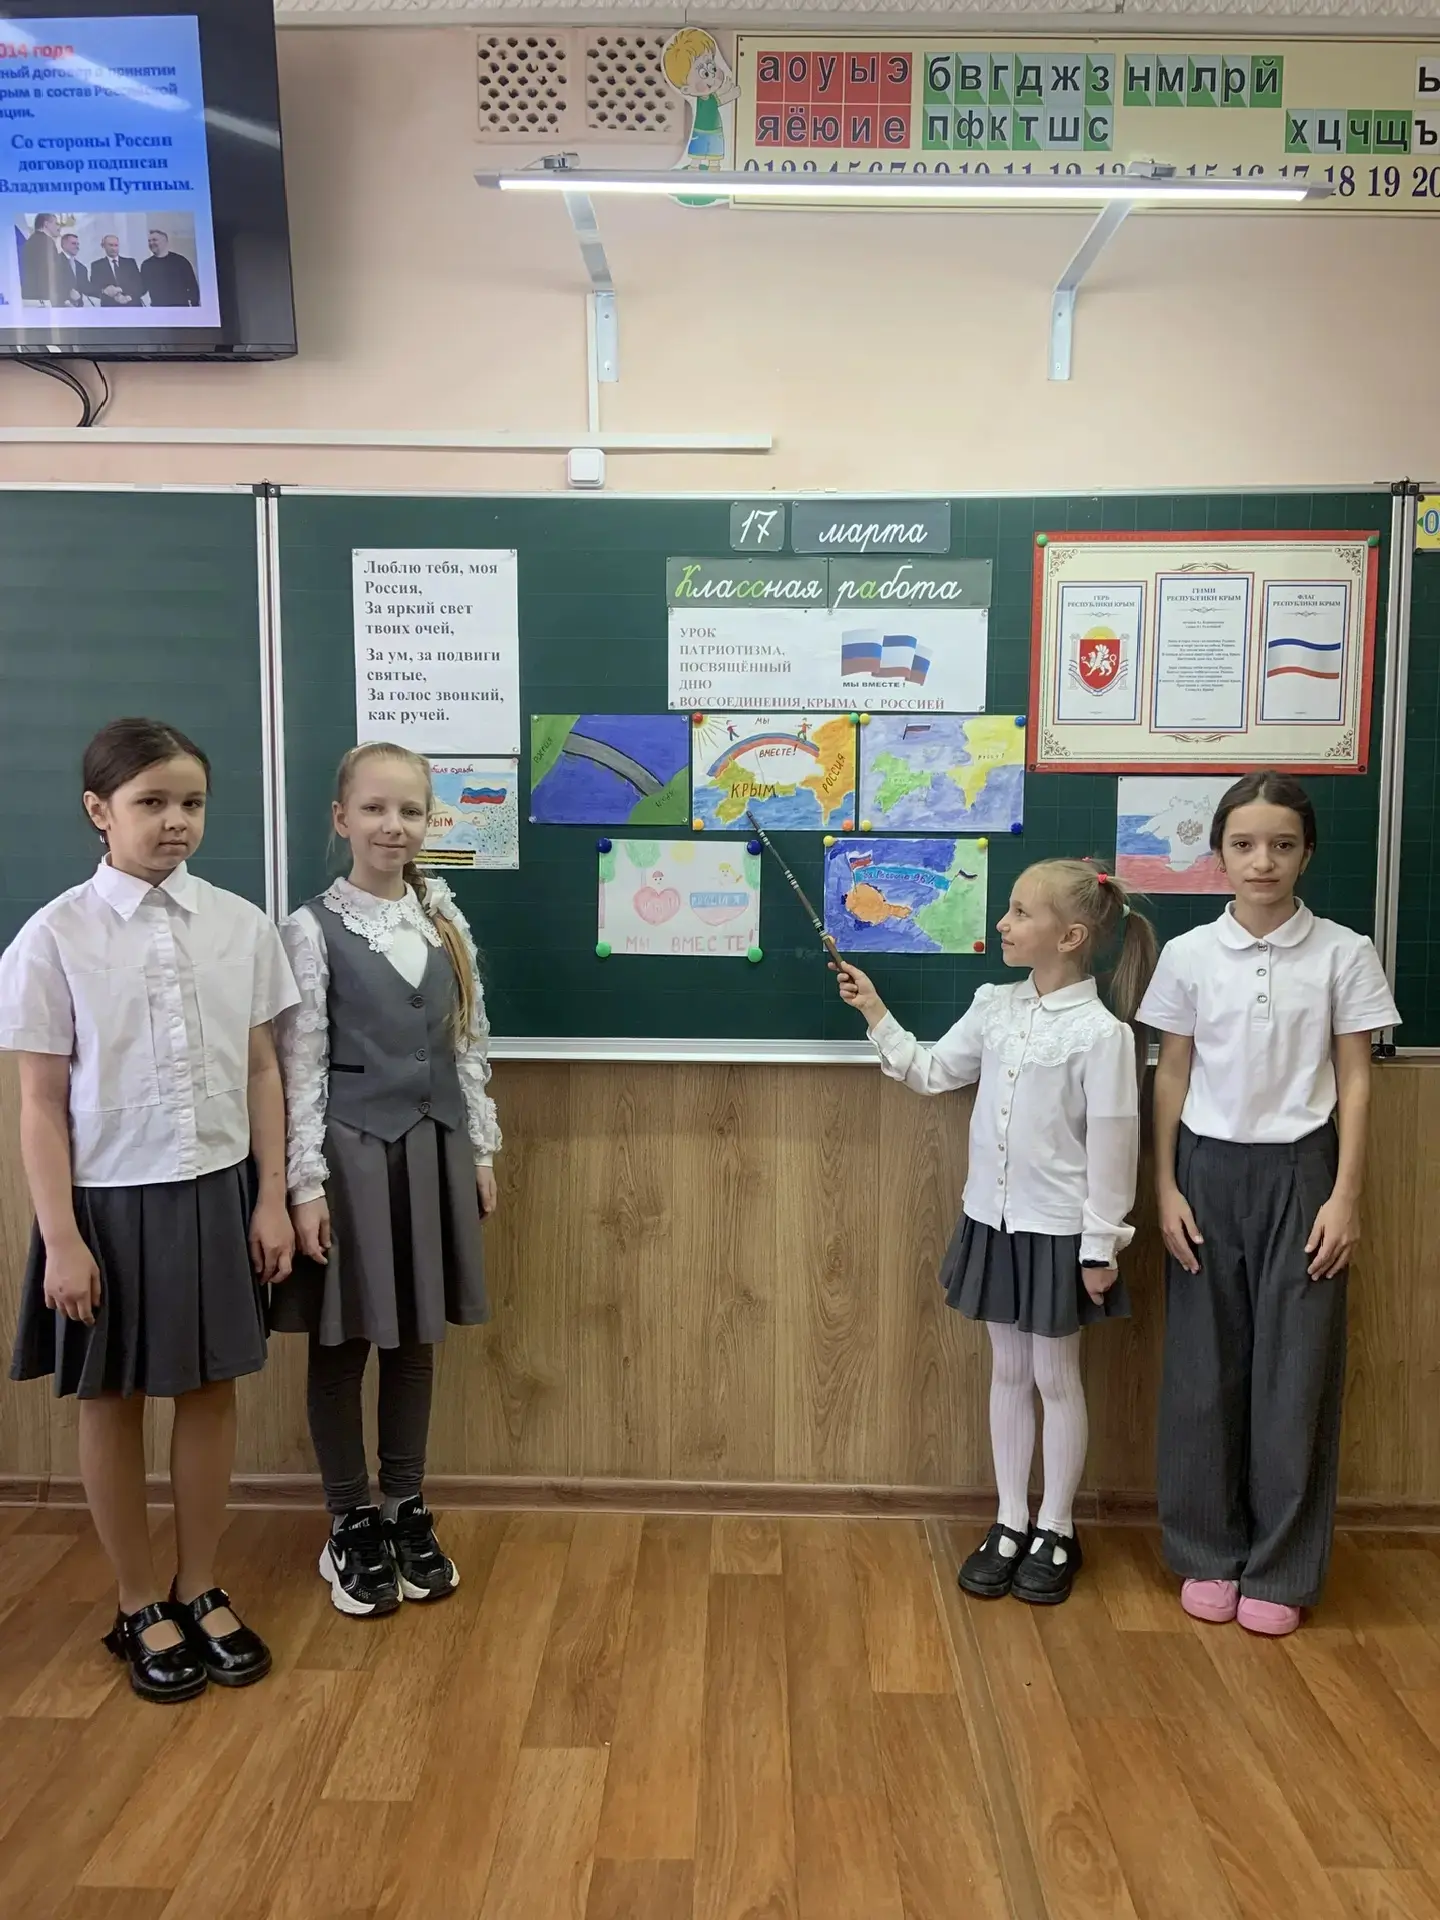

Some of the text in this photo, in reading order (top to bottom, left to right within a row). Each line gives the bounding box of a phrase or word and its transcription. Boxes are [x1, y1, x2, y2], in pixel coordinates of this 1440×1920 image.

[0, 66, 30, 79] ный
[47, 86, 91, 98] состав
[11, 133, 173, 151] Со стороны России
[18, 158, 168, 173] договор подписан
[0, 177, 194, 195] Владимиром Путиным.
[1368, 165, 1400, 197] 19
[740, 508, 928, 553] 17 марта
[363, 560, 498, 576] Люблю тебя, моя
[364, 580, 423, 596] Россия,
[674, 563, 963, 609] Классная работа
[364, 601, 473, 617] За яркий свет
[365, 622, 455, 636] твоих очей,
[679, 627, 717, 639] УРОК
[366, 648, 500, 664] За ум, за подвиги
[679, 660, 791, 676] ПОСВЯЩЁННЫЙ
[367, 670, 427, 683] святые,
[679, 679, 713, 692] ДНЮ
[367, 687, 504, 703] За голос звонкий,
[679, 696, 945, 711] ВОССОЕДИНЕНИЯ КРЫМА С РОССИЕЙ
[368, 709, 449, 724] как ручей.
[759, 744, 798, 758] ВМЕСТЕ!
[822, 753, 846, 794] РОССИЯ
[731, 783, 777, 798] КРЫМ
